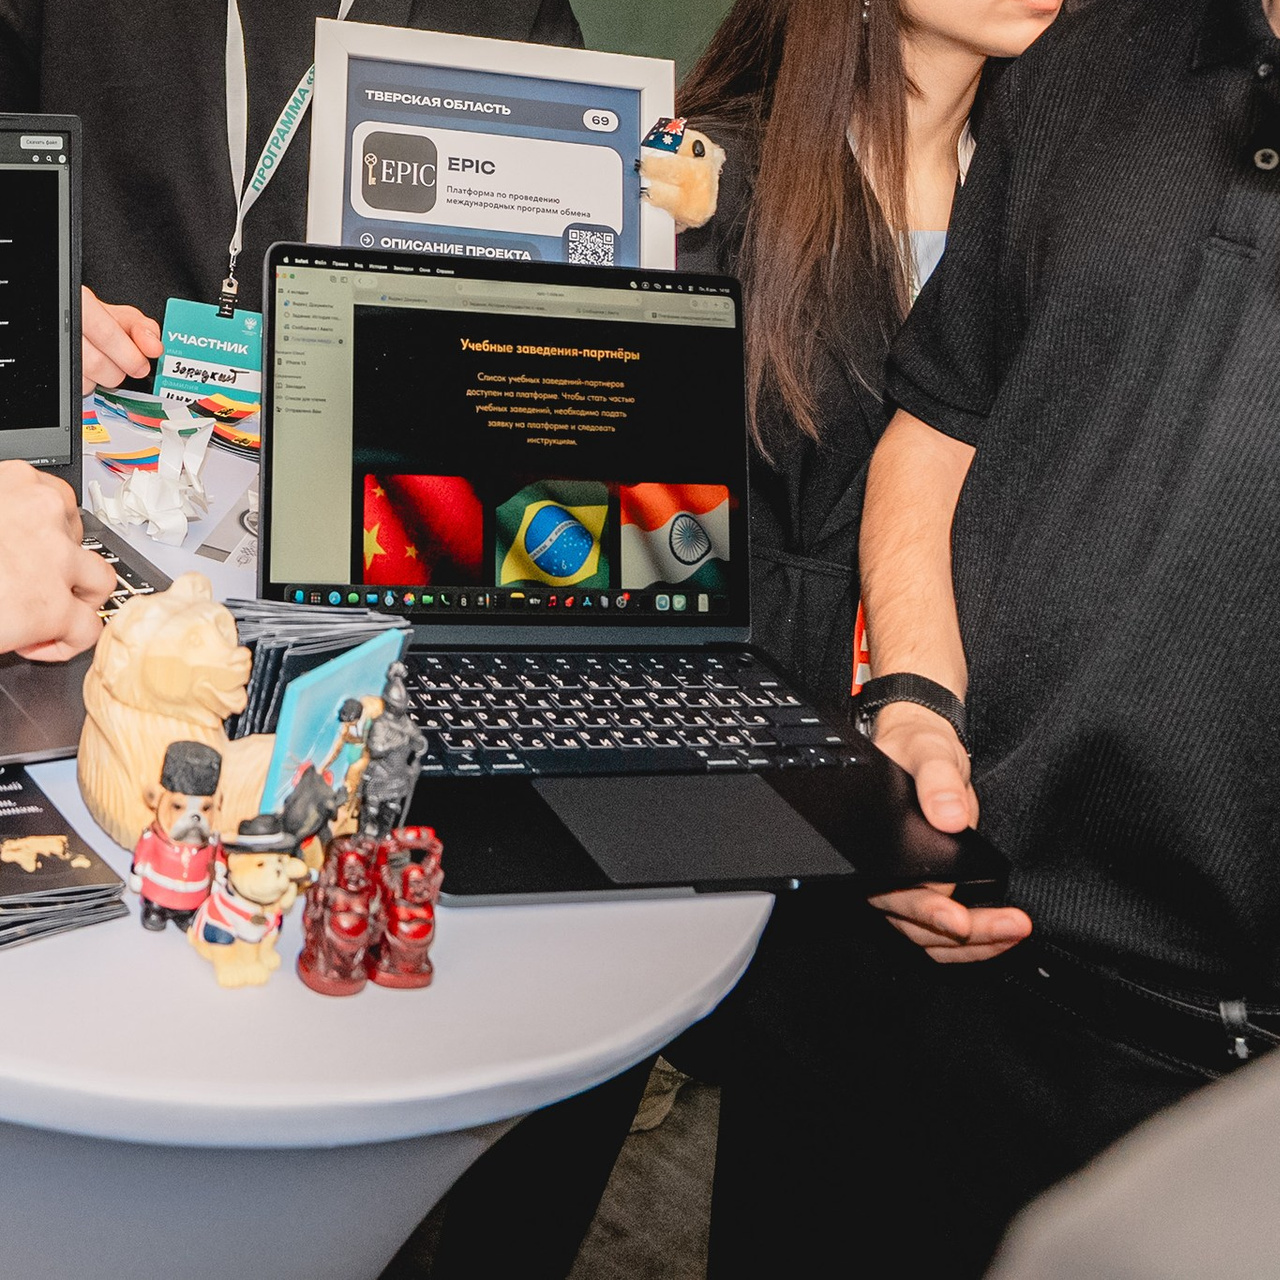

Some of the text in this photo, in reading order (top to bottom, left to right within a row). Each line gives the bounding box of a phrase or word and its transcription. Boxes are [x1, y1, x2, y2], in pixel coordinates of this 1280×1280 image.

[365, 89, 512, 116] ТВЕРСКАЯ ОБЛАСТЬ
[591, 115, 610, 126] 69
[251, 87, 310, 193] ПРОГРАММА
[380, 159, 436, 187] EPIC
[447, 156, 496, 175] EPIC
[446, 185, 561, 206] Платформа по проведению
[446, 196, 591, 219] международных программ обмена
[380, 236, 532, 261] ОПИСАНИЕ ПРОЕКТА
[167, 331, 250, 355] УЧАСТНИК
[460, 338, 640, 363] Учебные заведения-партнёры
[477, 372, 506, 382] Список
[508, 375, 540, 385] учебных
[466, 389, 503, 400] доступен
[516, 390, 560, 401] платформе.
[561, 392, 586, 401] Чтобы
[609, 396, 636, 404] частью
[475, 403, 627, 418] учебных заведений, необходимо подать
[488, 420, 514, 430] заявку
[527, 421, 569, 431] платформе
[577, 425, 616, 433] следовать
